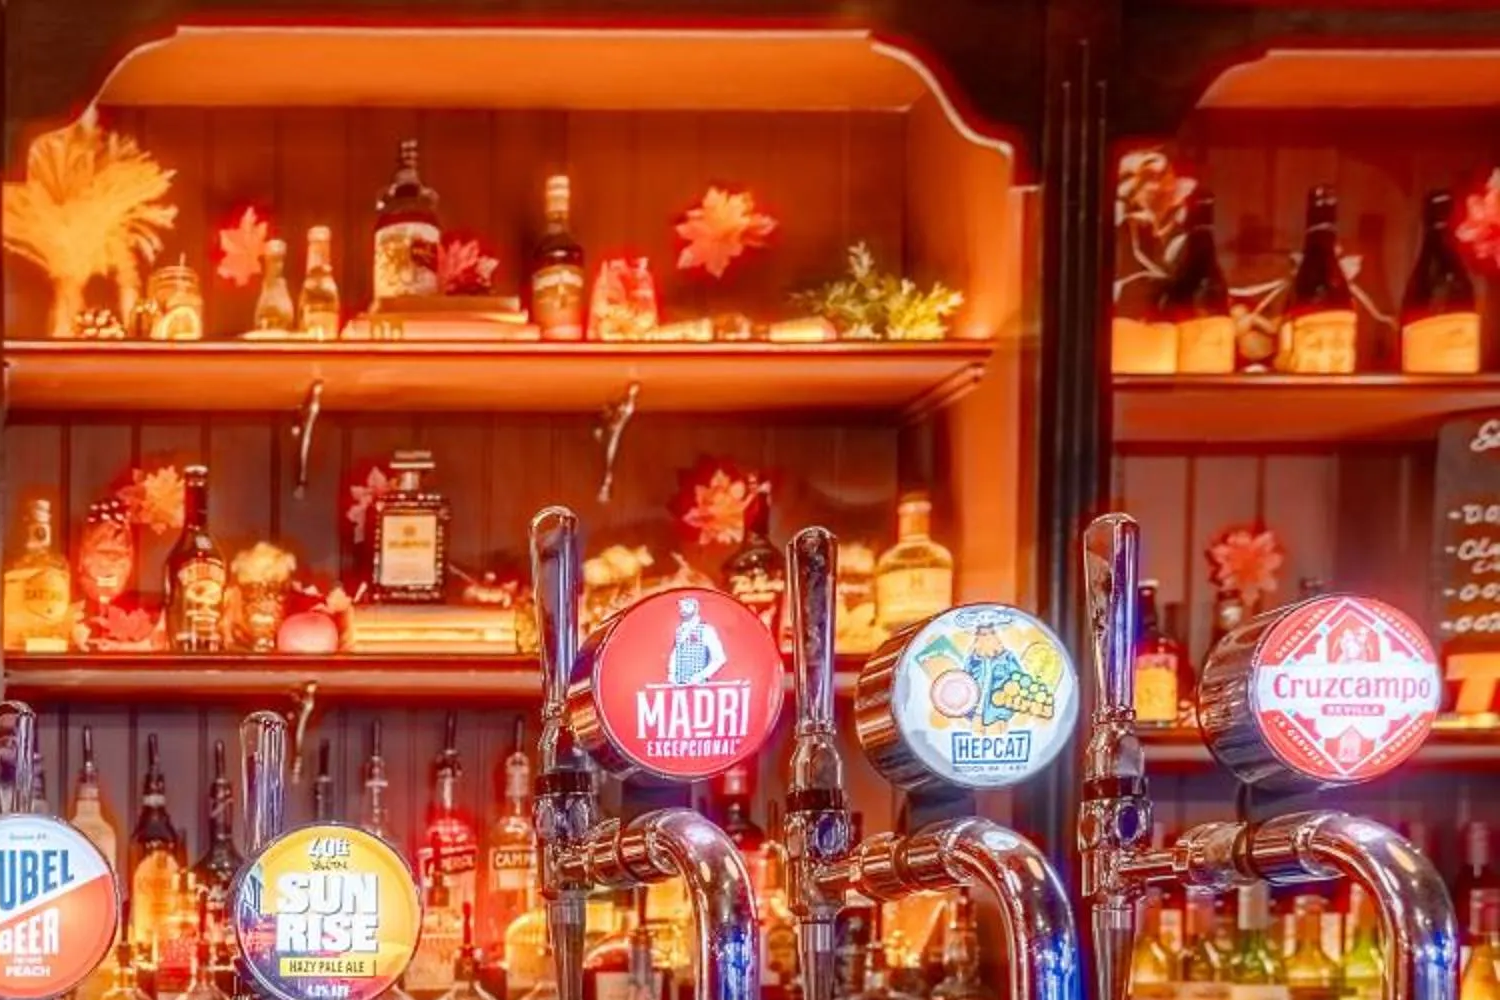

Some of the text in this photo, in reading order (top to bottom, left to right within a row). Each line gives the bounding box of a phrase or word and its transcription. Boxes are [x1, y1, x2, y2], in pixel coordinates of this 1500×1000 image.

[1272, 672, 1432, 704] Cruzcampo
[646, 740, 738, 758] EXCEPCIONAL
[957, 736, 1027, 759] HEPCAT
[277, 873, 378, 914] SUN
[276, 914, 379, 953] RISE
[289, 960, 365, 973] HAZY PALE ALE
